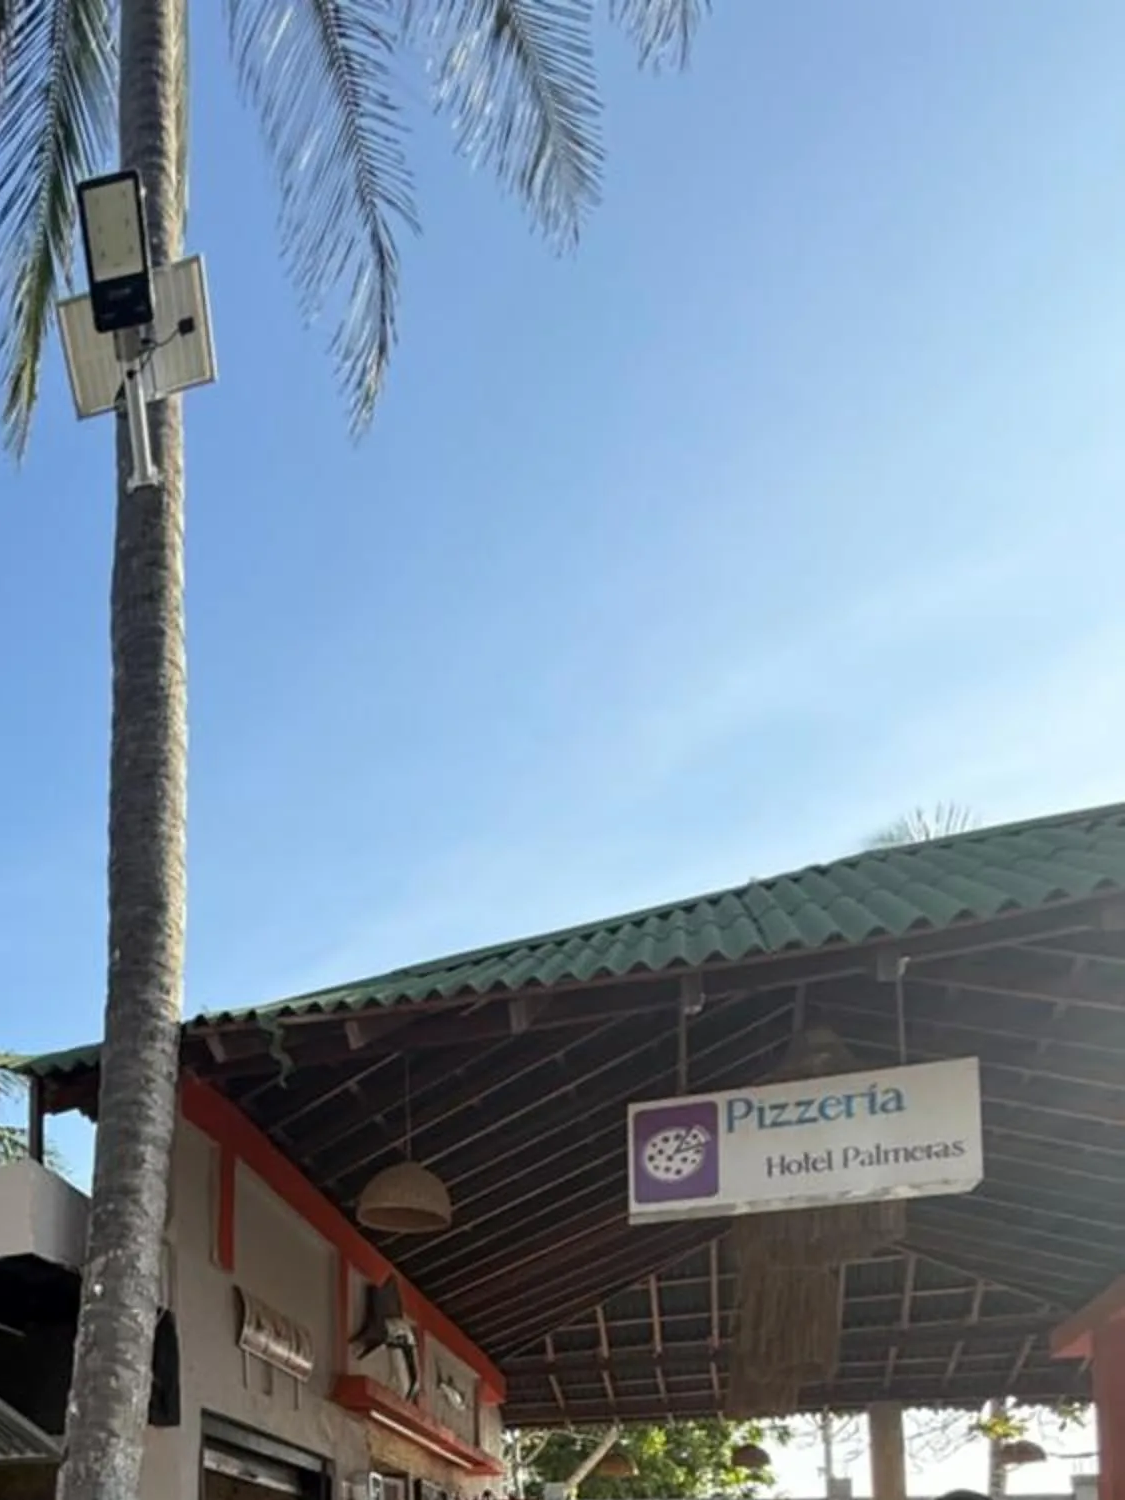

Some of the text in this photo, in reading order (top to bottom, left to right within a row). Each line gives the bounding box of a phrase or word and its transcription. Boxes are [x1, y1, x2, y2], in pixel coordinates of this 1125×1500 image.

[726, 1081, 906, 1134] Pizzería
[765, 1139, 966, 1178] Hotel Palmeras
